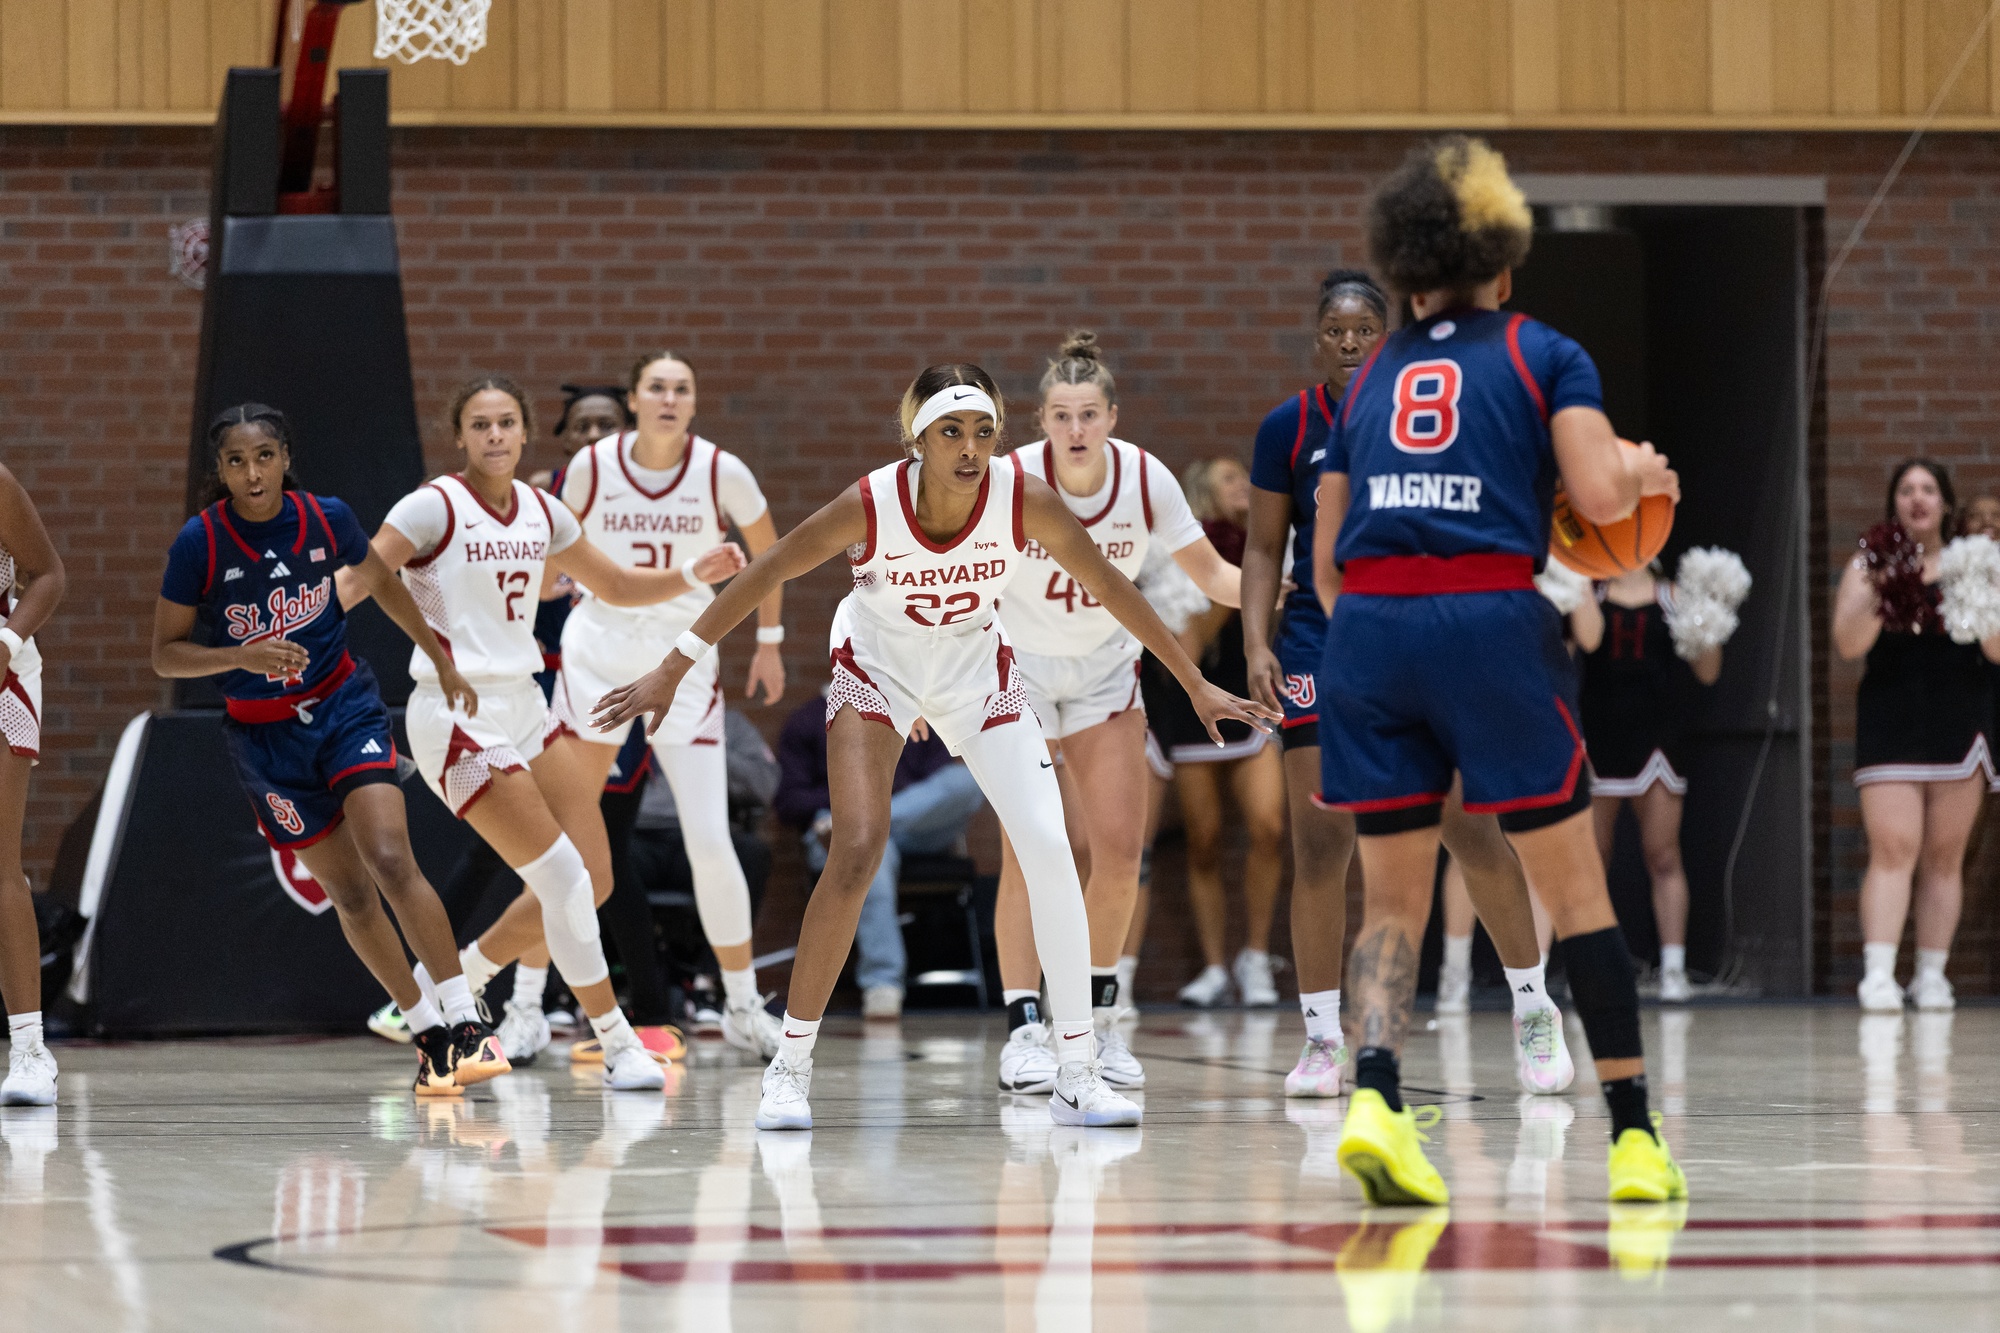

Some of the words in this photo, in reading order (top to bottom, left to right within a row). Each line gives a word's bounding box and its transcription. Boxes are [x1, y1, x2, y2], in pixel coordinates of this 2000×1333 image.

[1389, 358, 1463, 454] 8
[1367, 472, 1482, 513] WAGNER
[602, 512, 703, 533] HARVARD
[631, 543, 672, 569] 31
[974, 541, 990, 551] Ivy
[885, 559, 1006, 587] HARVARD
[496, 571, 530, 622] 12
[904, 591, 980, 626] 22
[225, 603, 266, 640] St.
[1611, 610, 1647, 660] H
